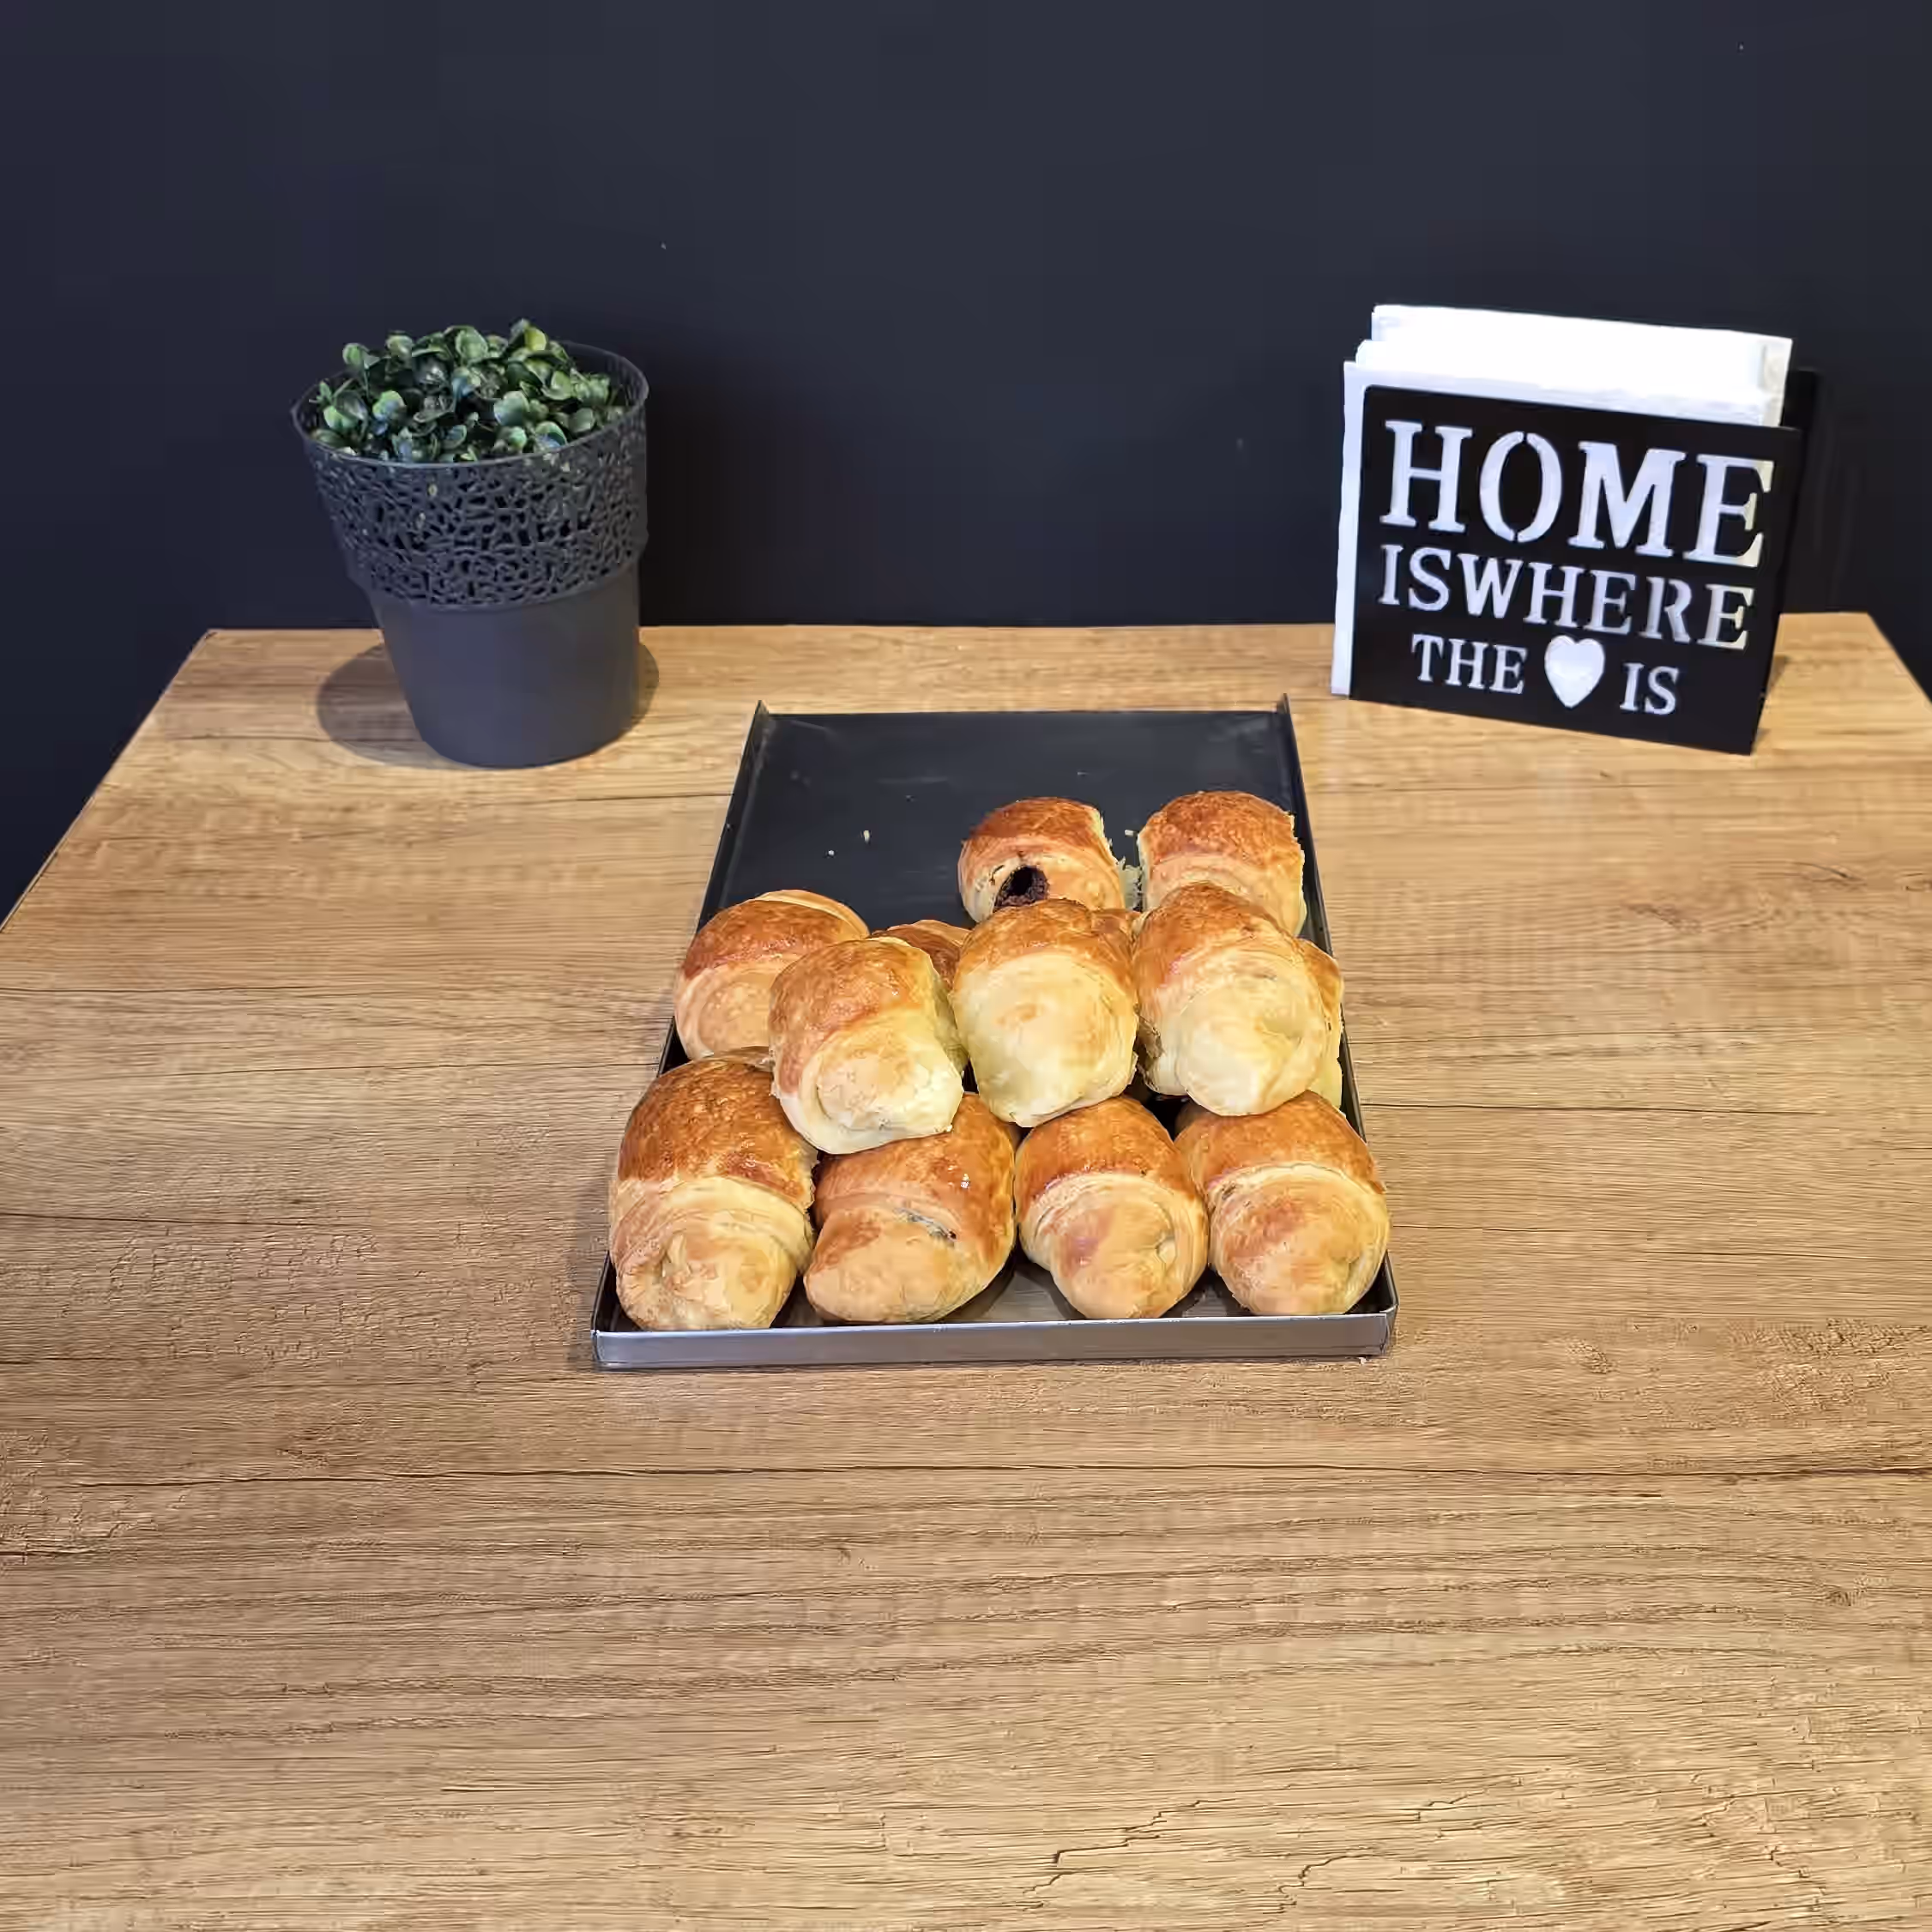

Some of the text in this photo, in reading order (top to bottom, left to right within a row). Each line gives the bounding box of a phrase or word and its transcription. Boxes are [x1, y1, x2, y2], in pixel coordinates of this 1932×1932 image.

[1380, 420, 1774, 568] HOME
[1411, 633, 1680, 715] THE IS
